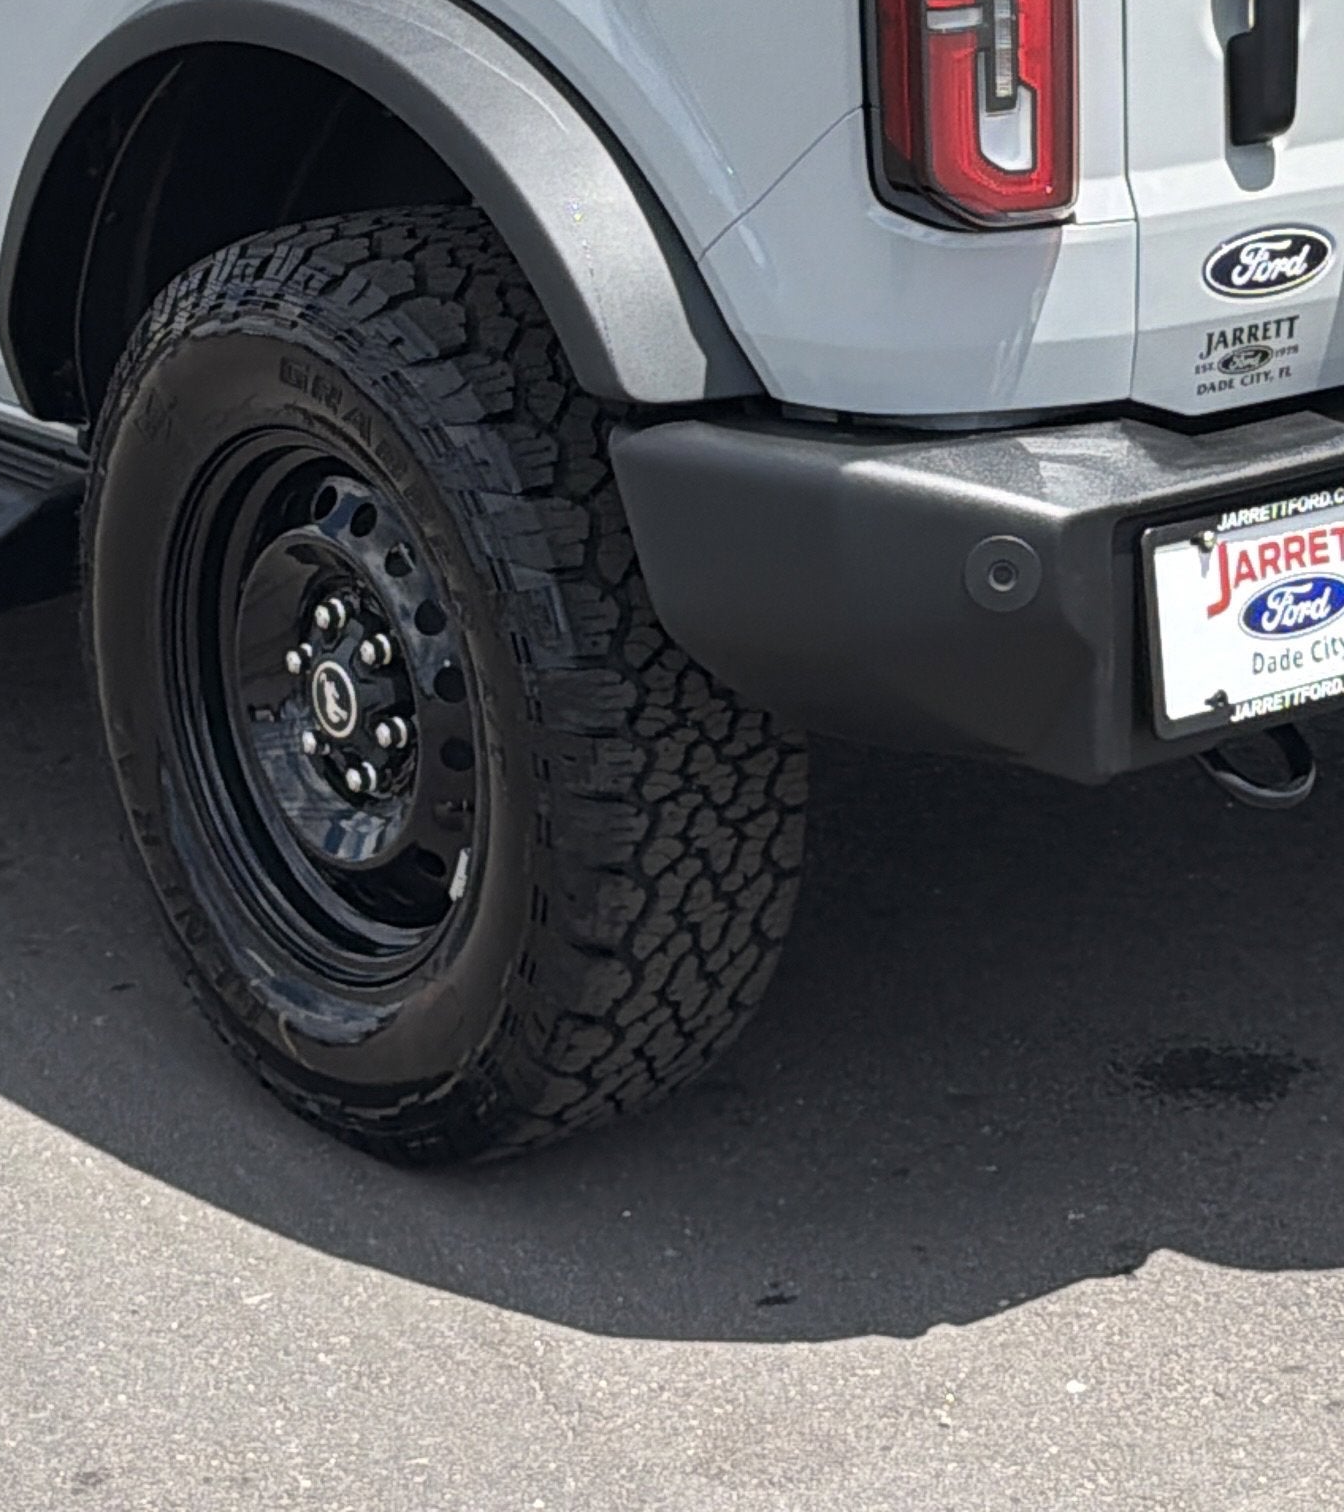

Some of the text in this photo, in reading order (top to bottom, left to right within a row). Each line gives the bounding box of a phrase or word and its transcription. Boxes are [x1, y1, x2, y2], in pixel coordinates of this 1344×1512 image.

[1231, 239, 1312, 286] Ford
[1199, 314, 1300, 360] JARRETT
[1196, 365, 1293, 396] DADE CITY, FL
[1261, 582, 1333, 632] Ford
[1252, 648, 1304, 676] Dade
